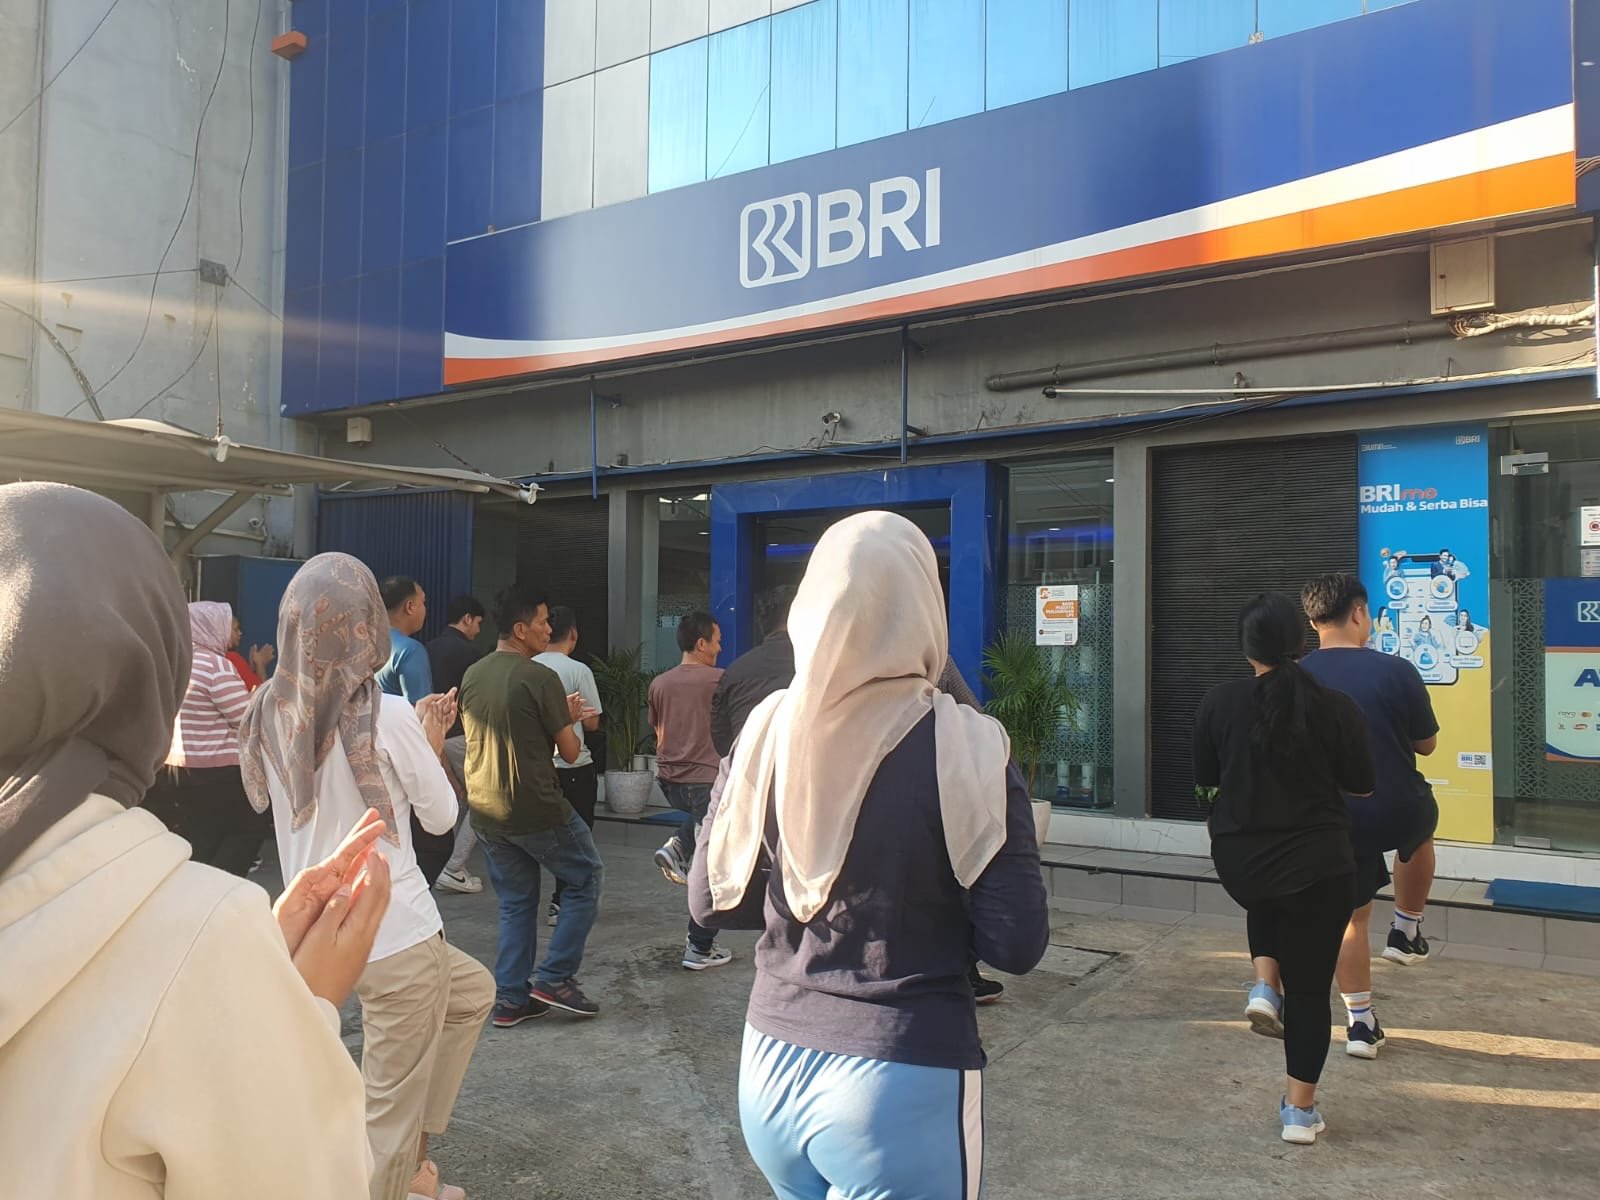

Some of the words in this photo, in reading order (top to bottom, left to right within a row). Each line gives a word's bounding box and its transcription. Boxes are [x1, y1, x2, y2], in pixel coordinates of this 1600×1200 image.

[817, 167, 941, 268] BRI
[1360, 503, 1403, 514] Mudah
[1406, 502, 1416, 511] &
[1419, 500, 1457, 511] Serba
[1459, 498, 1488, 509] Bisa
